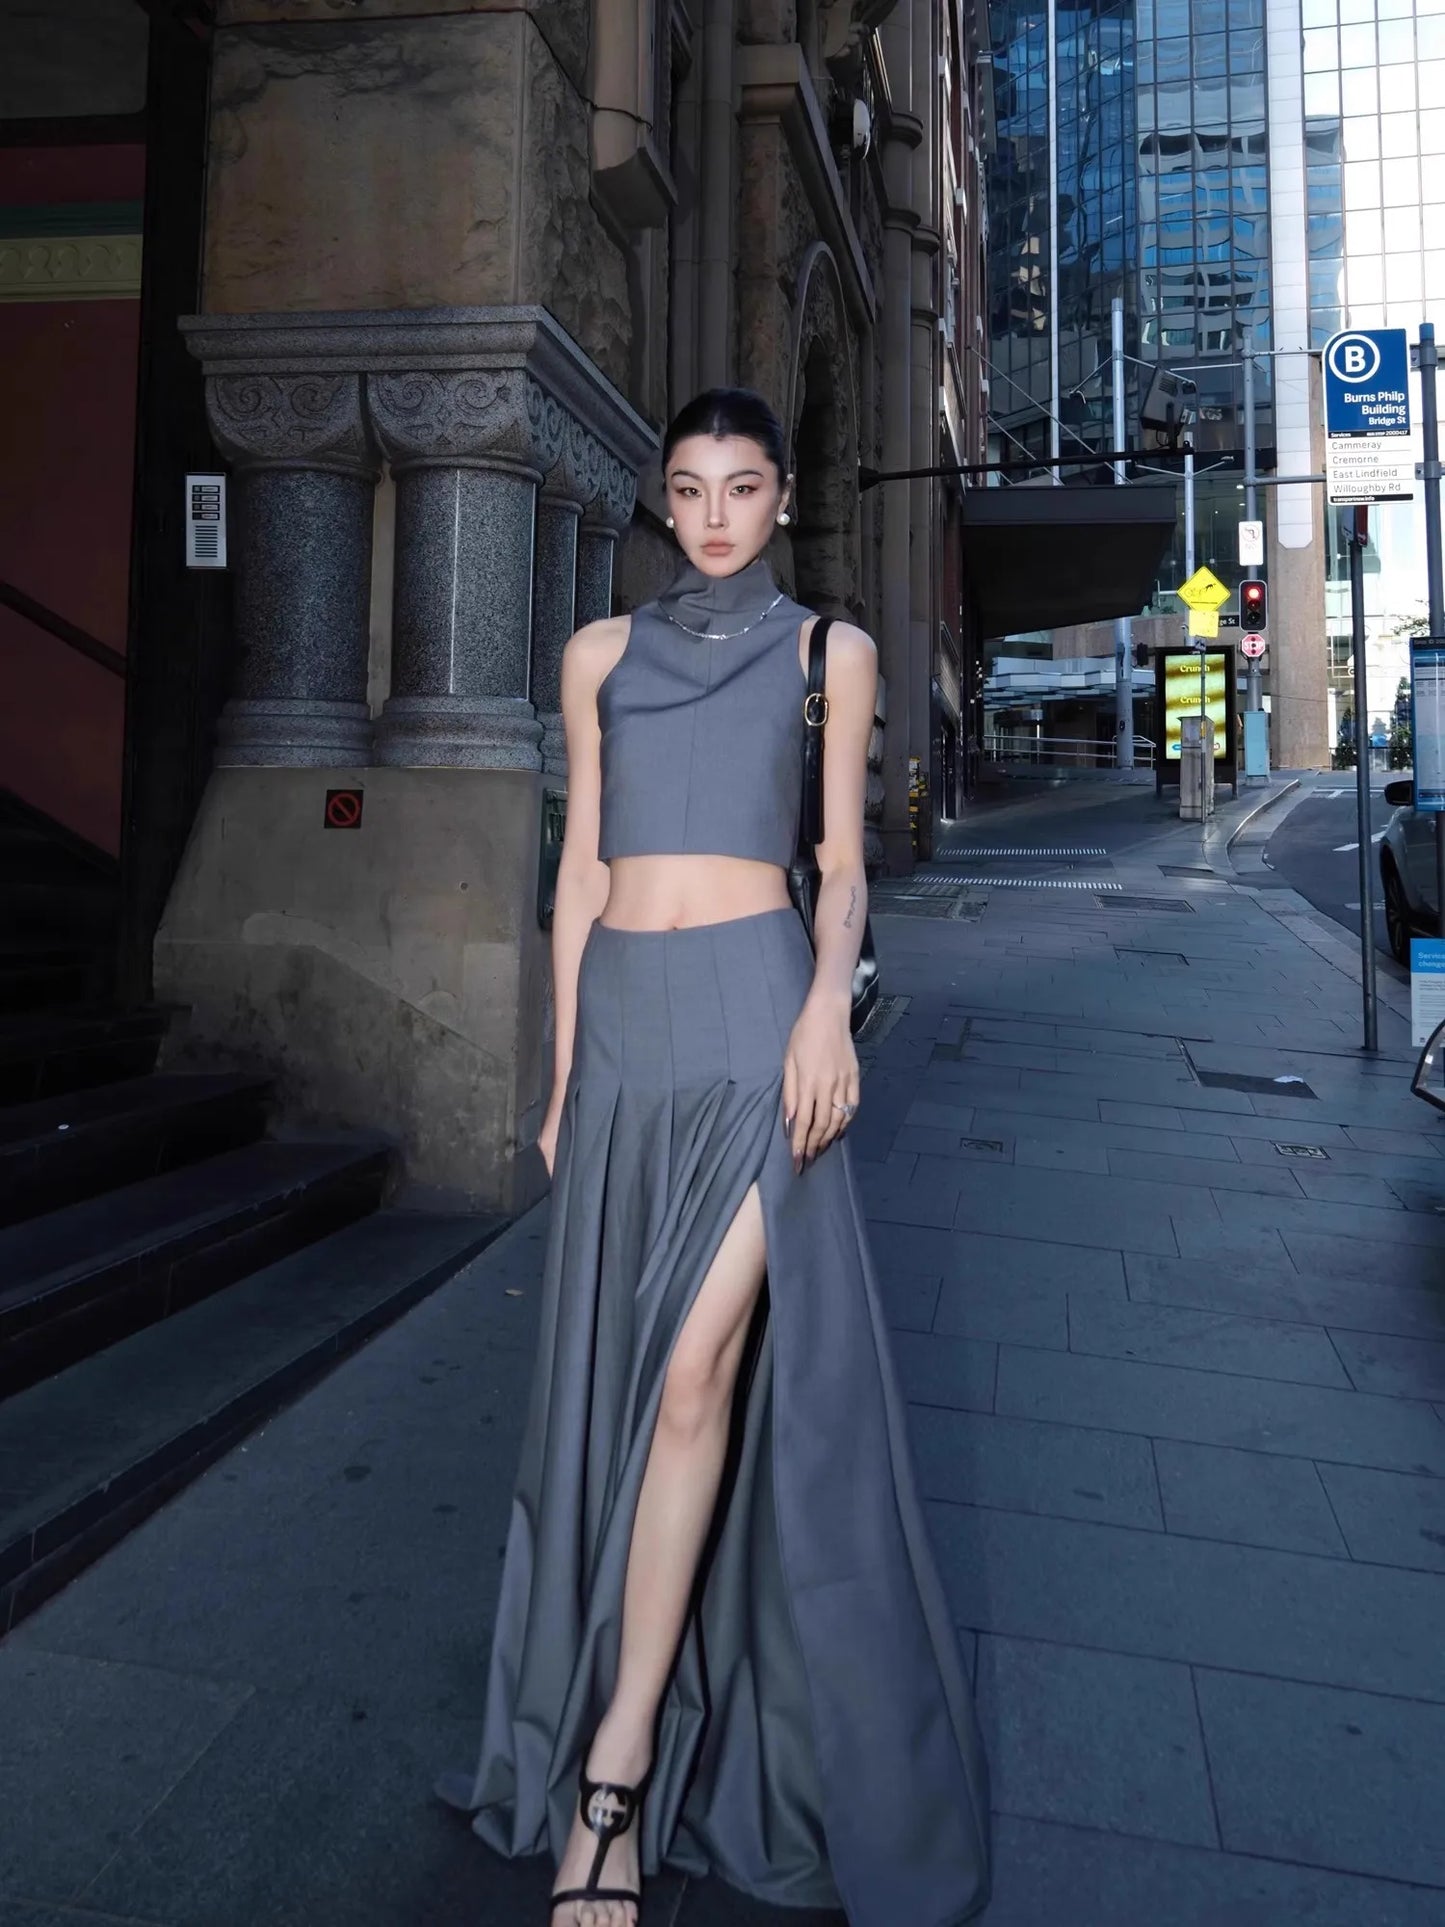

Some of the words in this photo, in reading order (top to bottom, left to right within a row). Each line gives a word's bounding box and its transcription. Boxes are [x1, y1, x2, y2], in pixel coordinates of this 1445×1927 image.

[1345, 345, 1366, 373] B
[1344, 393, 1376, 403] Burns
[1378, 391, 1405, 403] Philp
[1361, 404, 1406, 416] Building
[1368, 417, 1396, 426] Bridge
[1397, 416, 1406, 424] St
[1331, 441, 1382, 450] Cammeray
[1332, 456, 1379, 464] Cremorne
[1333, 470, 1353, 478] East
[1355, 468, 1398, 478] Lindfield
[1333, 484, 1386, 494] Willoughby
[1388, 483, 1401, 491] Rd
[1180, 665, 1210, 673] Crunh
[1180, 695, 1210, 704] Crunh
